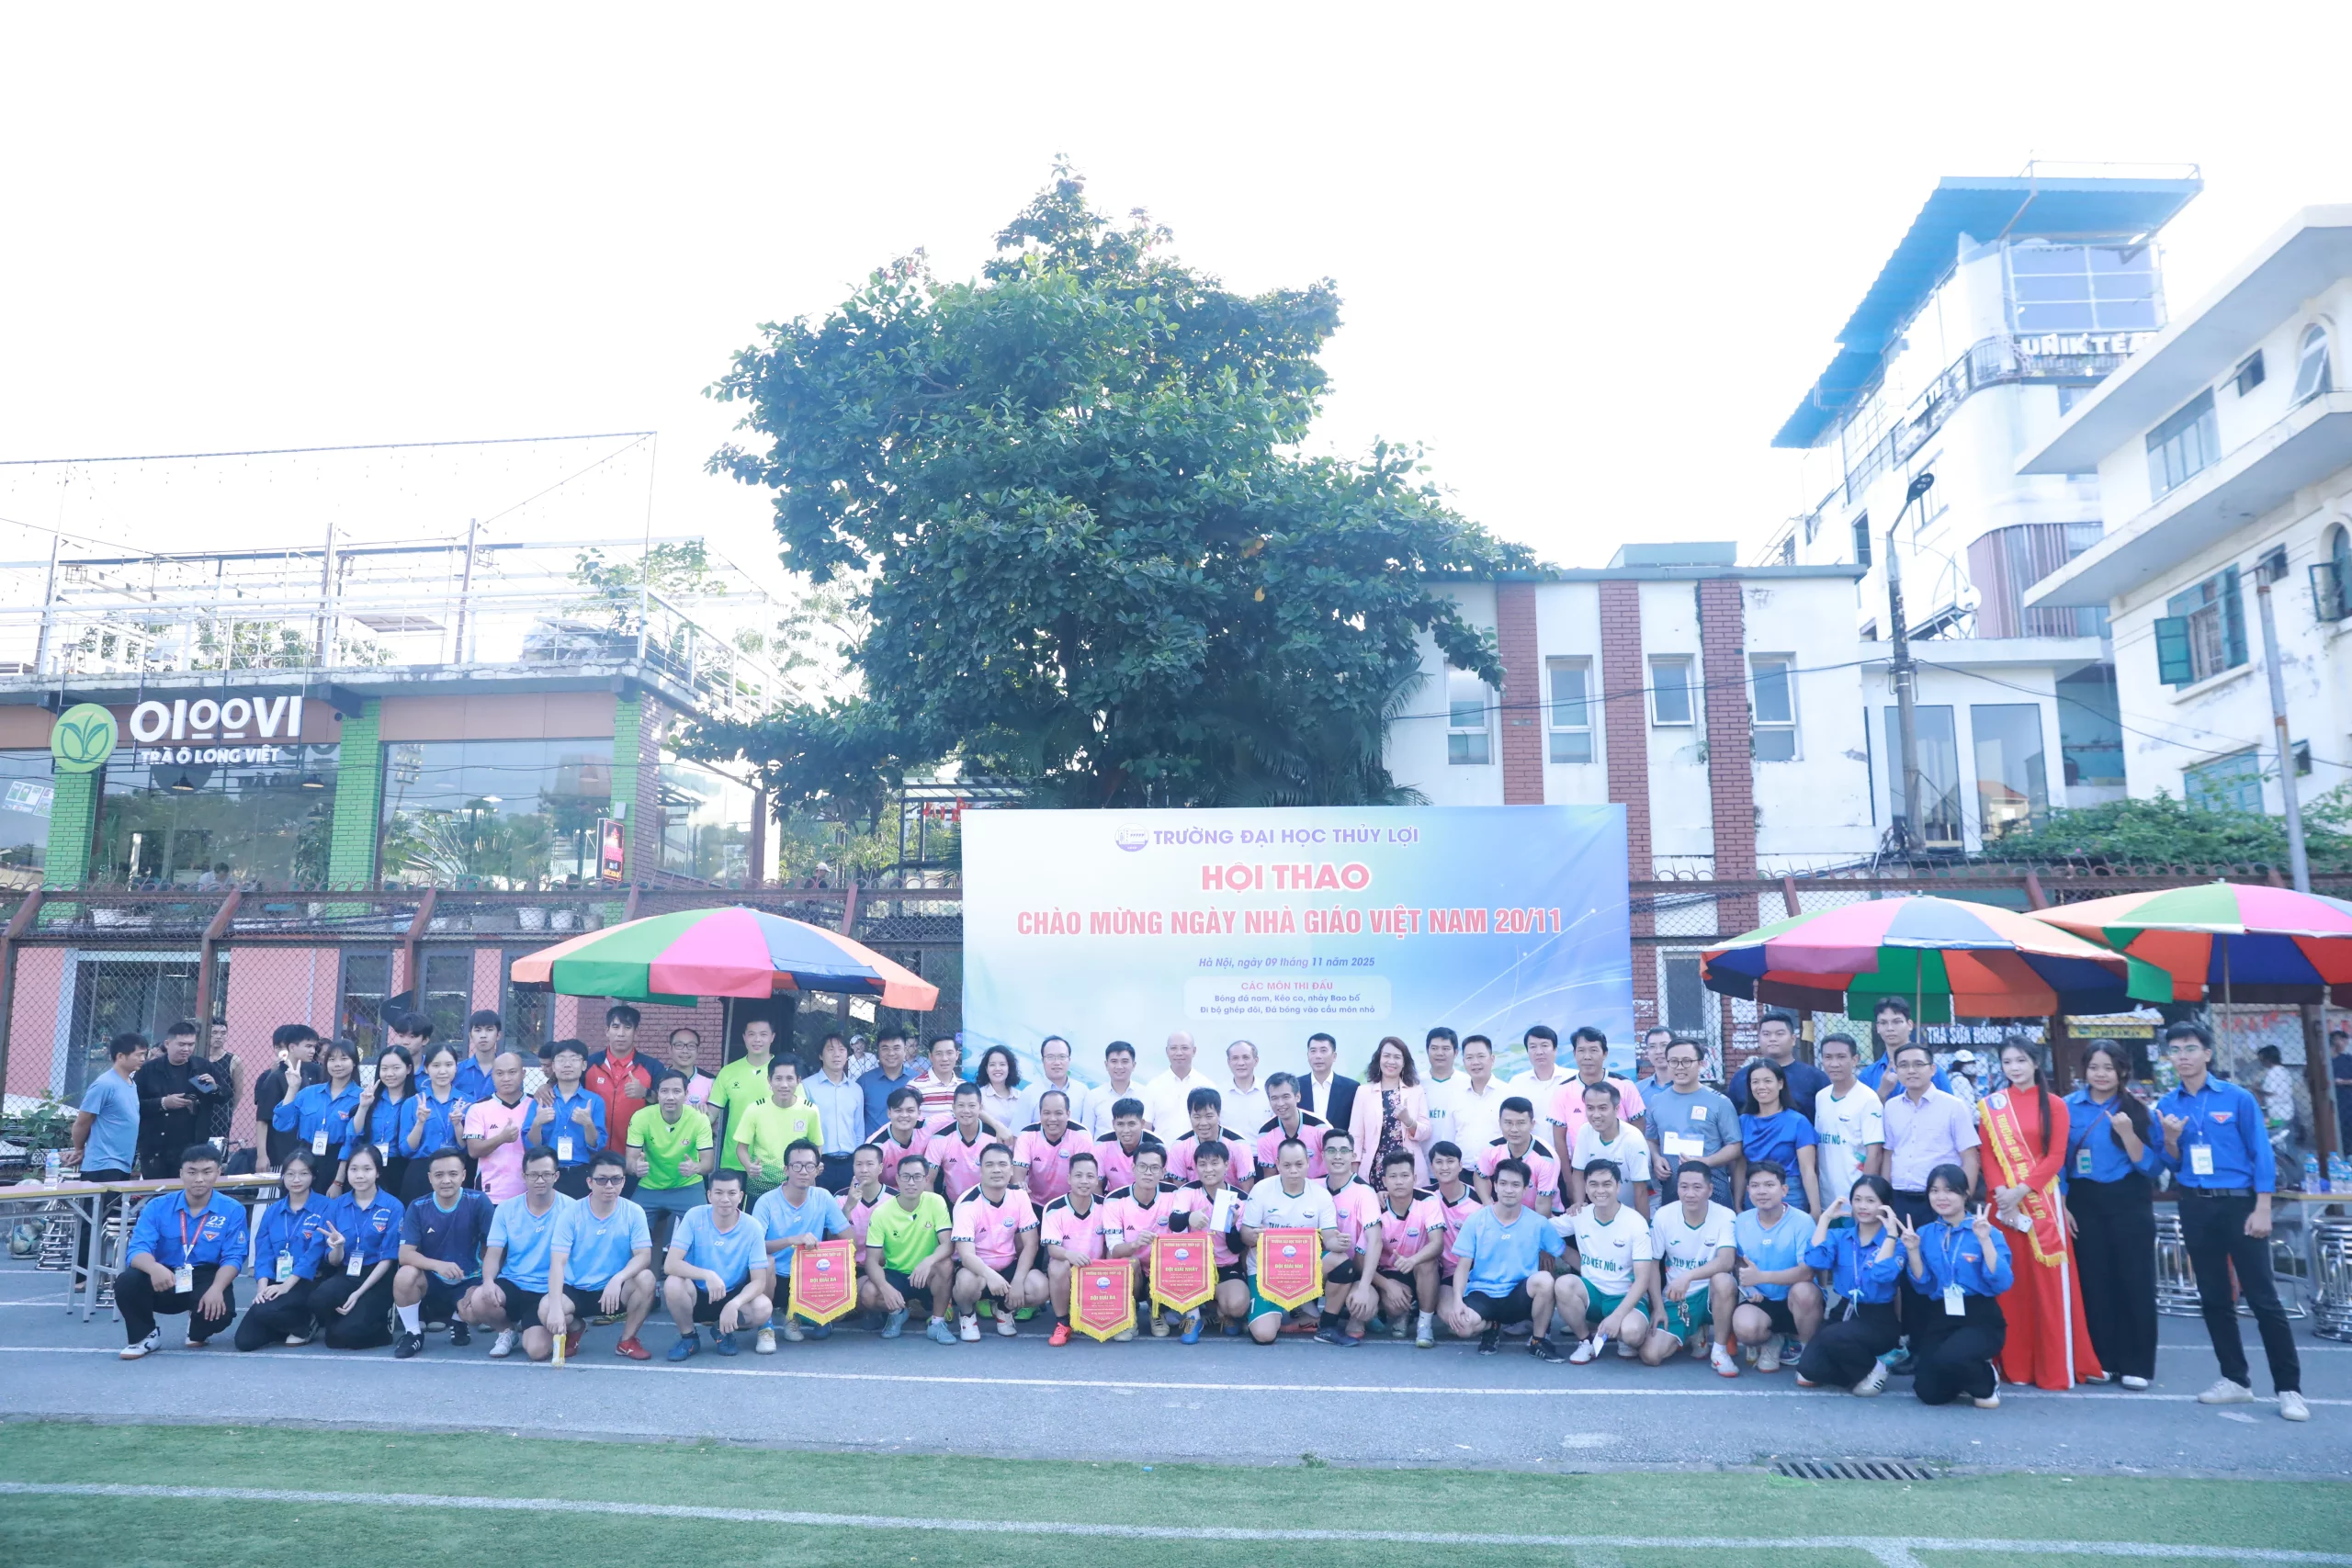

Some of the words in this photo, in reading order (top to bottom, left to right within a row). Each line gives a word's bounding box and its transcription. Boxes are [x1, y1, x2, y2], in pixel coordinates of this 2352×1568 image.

[141, 746, 174, 765] TRÀ
[176, 746, 192, 764] Ô
[194, 748, 241, 764] LONG
[244, 744, 280, 764] VIỆT
[1153, 826, 1234, 845] TRƯỜNG
[1240, 829, 1274, 848] ĐẠI
[1281, 829, 1327, 848] HỌC
[1332, 823, 1381, 843] THỦY
[1388, 826, 1419, 847] LỢI
[1202, 862, 1263, 893] HỘI
[1272, 863, 1370, 890] THAO
[1017, 907, 1081, 935] CHÀO
[1090, 907, 1162, 935] MỪNG
[1170, 906, 1237, 934] NGÀY
[1244, 905, 1296, 934] NHÀ
[1304, 905, 1361, 933] GIÁO
[1369, 904, 1422, 939] VIỆT
[1429, 908, 1487, 933] NAM
[1495, 908, 1561, 933] 20/11
[1199, 958, 1213, 967] Hà
[1216, 958, 1235, 970] Nội,
[1238, 958, 1262, 969] ngày
[1265, 958, 1277, 967] 09
[1280, 958, 1308, 969] tháng
[1312, 957, 1323, 966] 11
[1326, 957, 1349, 966] năm
[1351, 957, 1375, 966] 2025
[1241, 980, 1264, 990] CÁC
[1267, 980, 1291, 990] MÔN
[1294, 982, 1308, 990] THI
[1312, 978, 1333, 990] ĐẤU
[1215, 995, 1236, 1003] Bóng
[1211, 1006, 1222, 1014] bộ
[1224, 1006, 1245, 1015] ghép
[1279, 1006, 1301, 1015] bóng
[207, 1215, 226, 1226] 23
